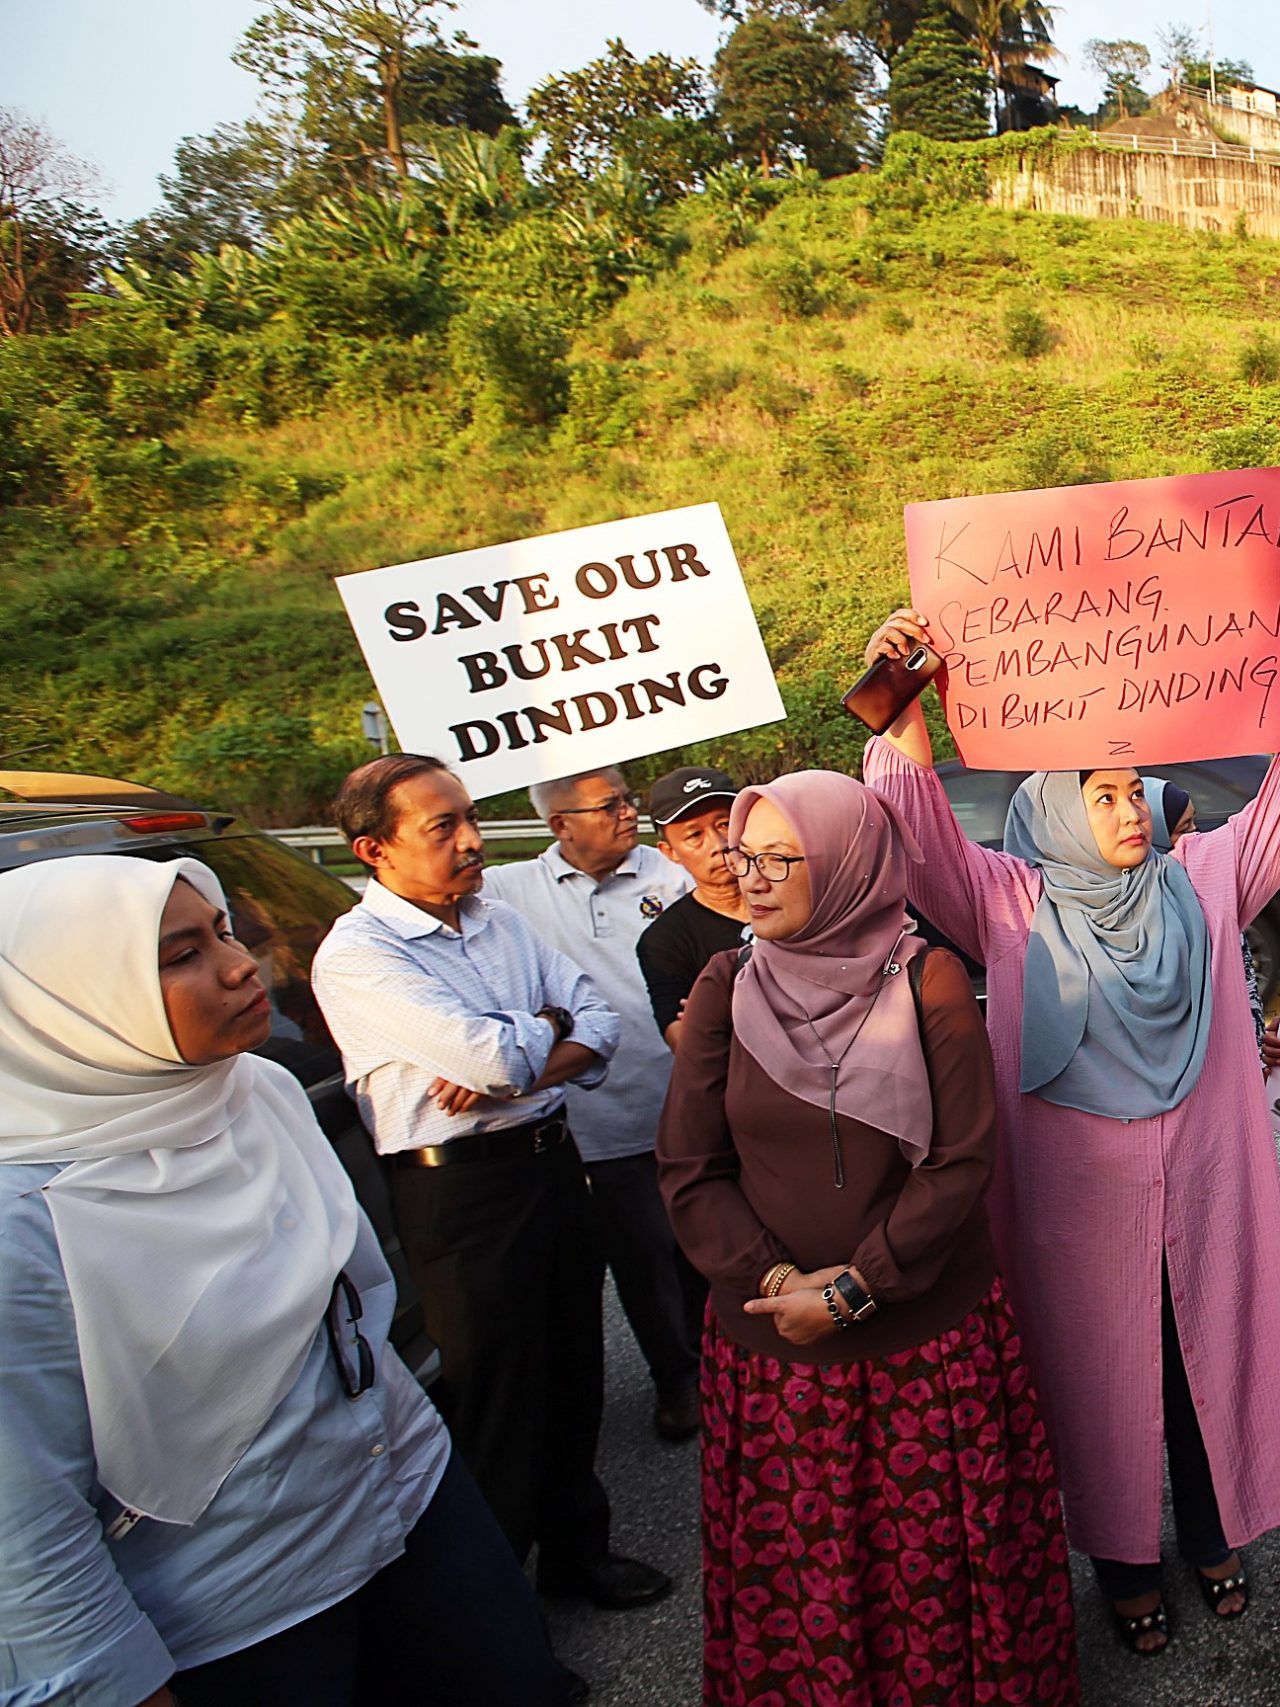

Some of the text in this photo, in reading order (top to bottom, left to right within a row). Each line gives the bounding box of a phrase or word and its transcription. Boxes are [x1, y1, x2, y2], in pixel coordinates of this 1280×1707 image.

[384, 542, 710, 642] SAVE OUR
[934, 520, 1083, 586] KAMI
[457, 614, 661, 694] BUKIT
[1001, 687, 1105, 730] BUKIT
[1117, 655, 1278, 728] DINDING
[448, 663, 729, 762] DINDING
